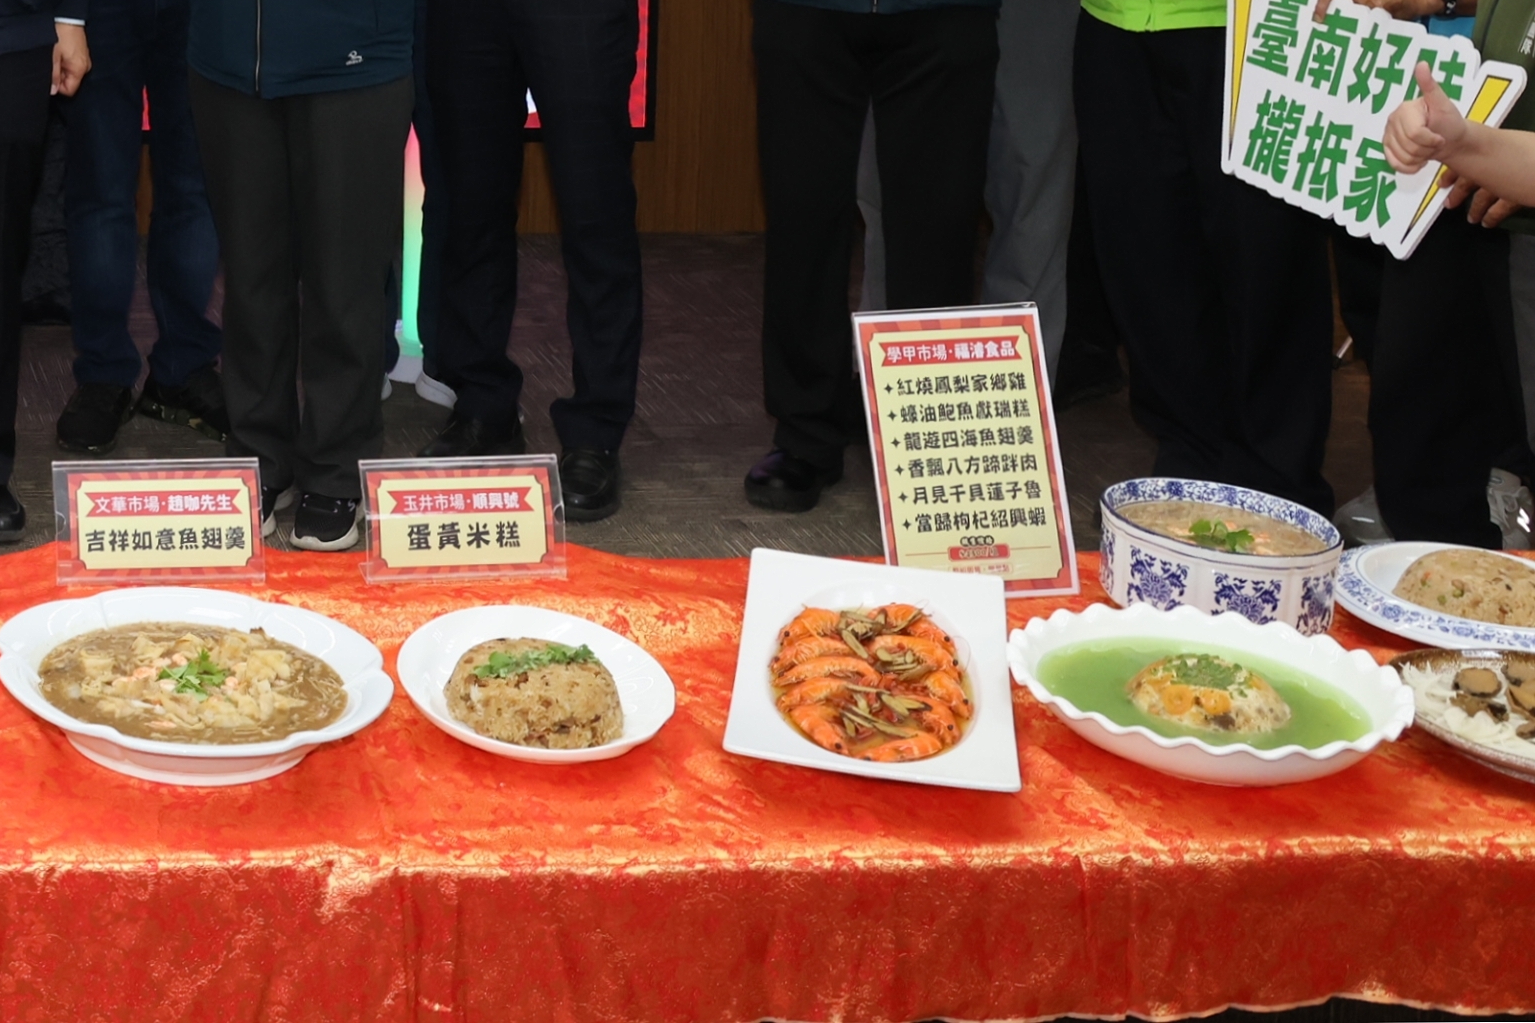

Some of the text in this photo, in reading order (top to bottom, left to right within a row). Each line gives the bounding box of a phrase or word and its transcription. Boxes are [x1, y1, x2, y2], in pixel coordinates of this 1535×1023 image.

[895, 371, 1028, 397] 紅燒鳳梨家鄉雞
[899, 398, 1032, 425] 蠔油鮑魚獻瑞糕
[903, 425, 1035, 452] 龍遊四海魚翅羹
[915, 506, 1048, 534] 當歸枸杞紹興蝦
[84, 525, 247, 553] 吉祥如意魚翅羹
[406, 521, 522, 552] 蛋黃米糕
